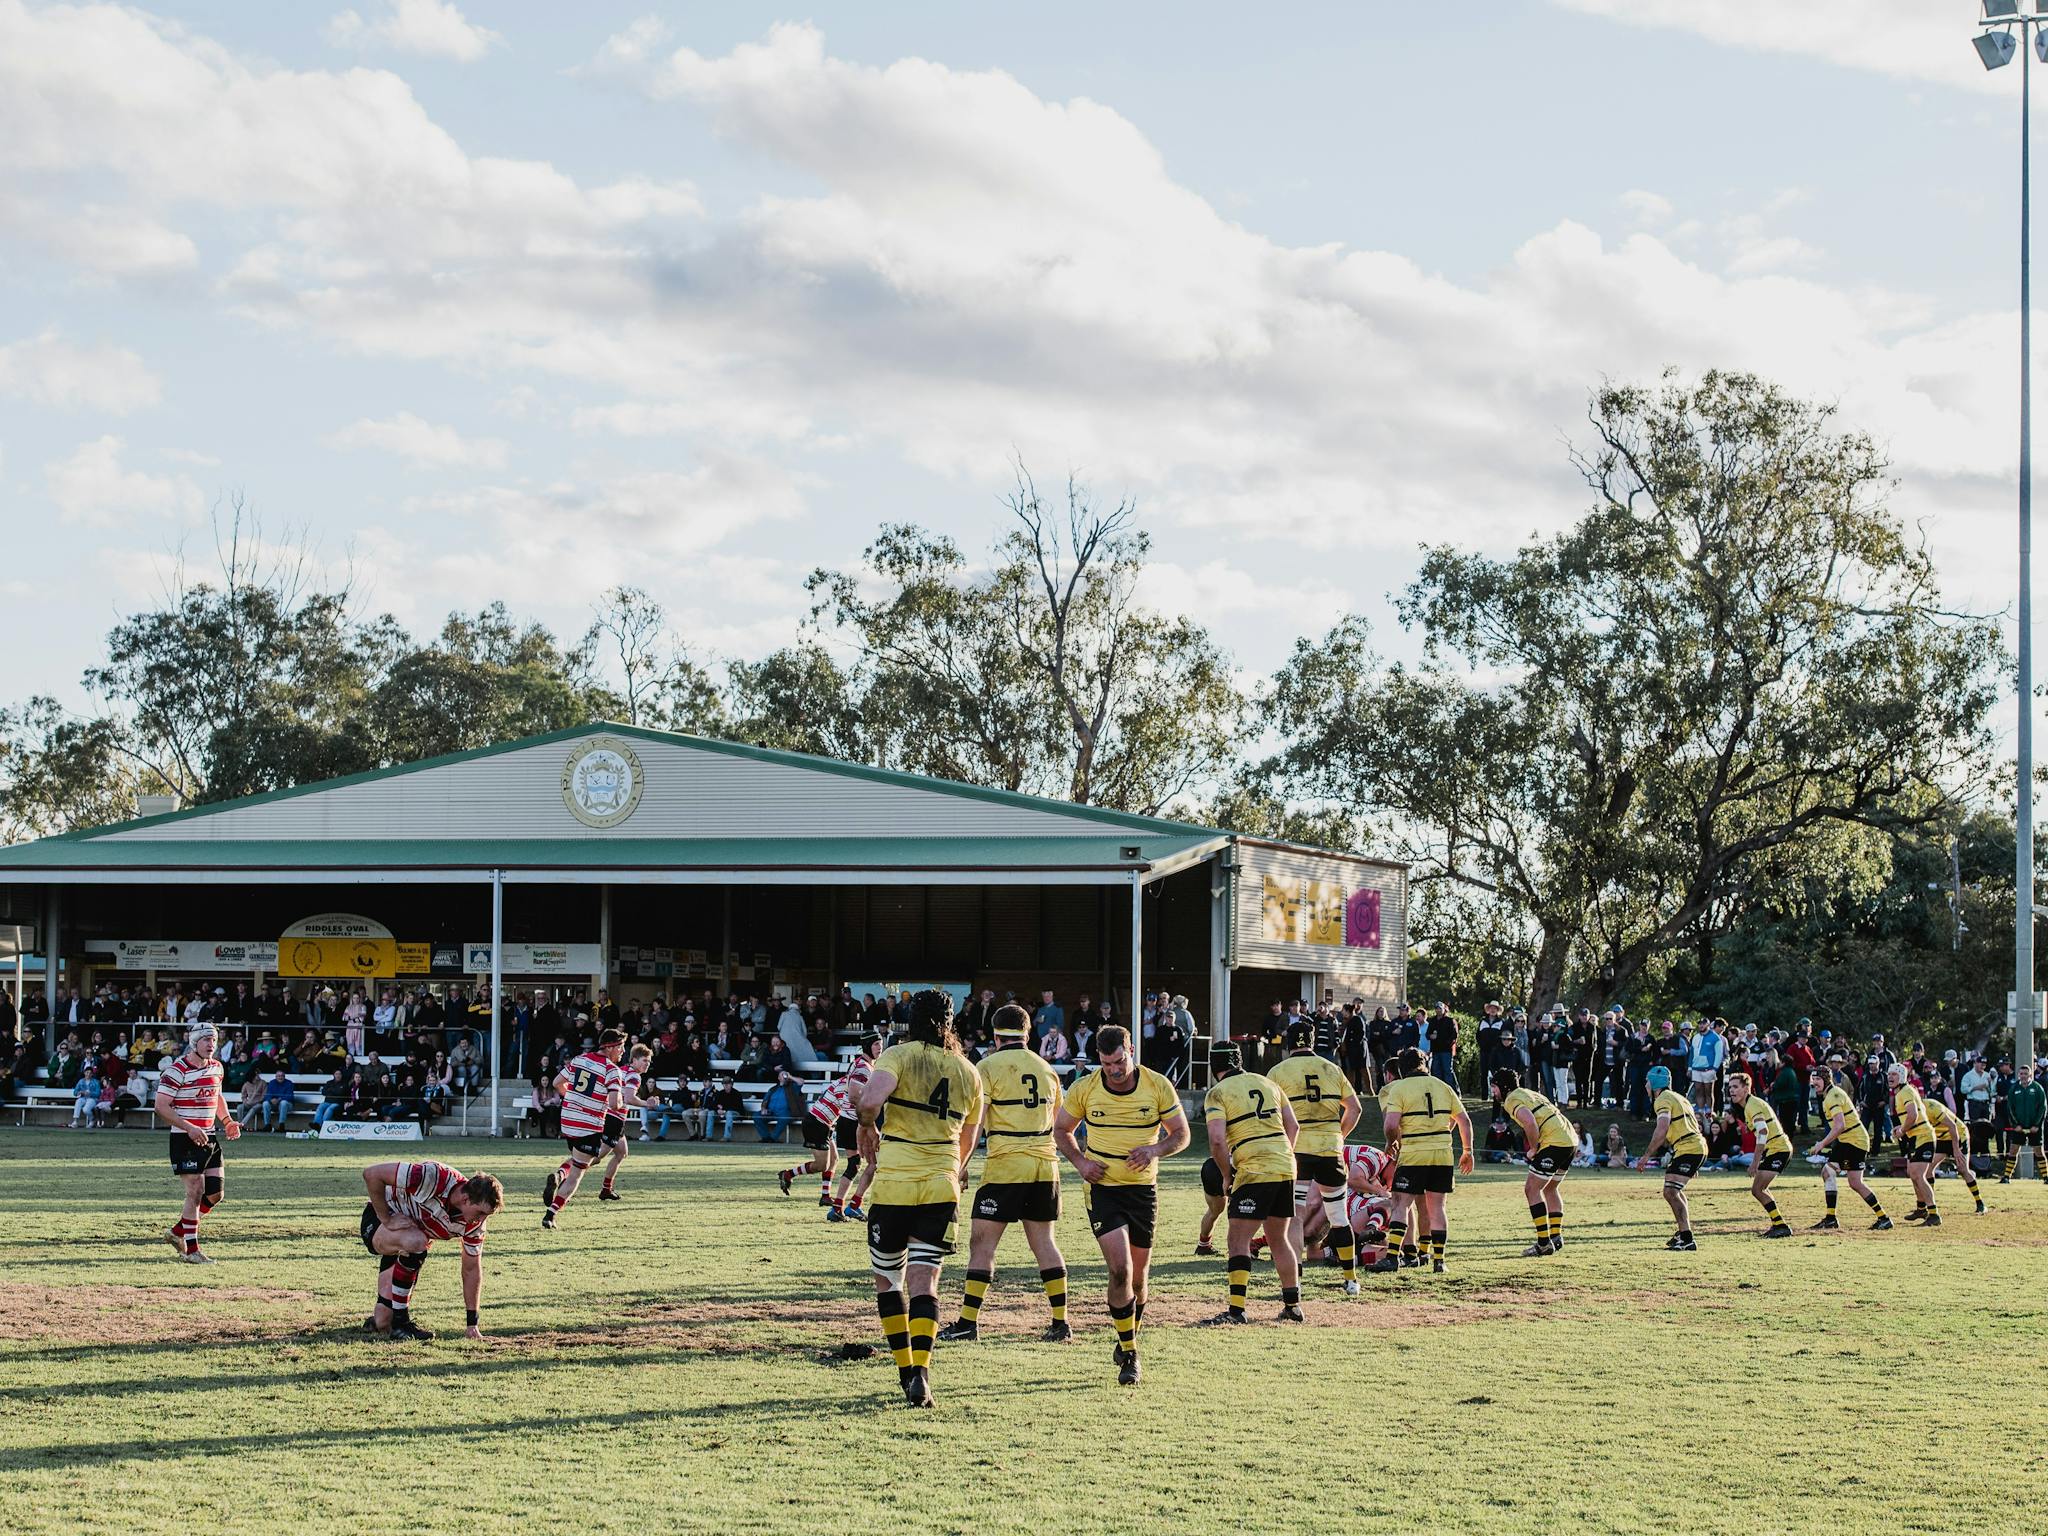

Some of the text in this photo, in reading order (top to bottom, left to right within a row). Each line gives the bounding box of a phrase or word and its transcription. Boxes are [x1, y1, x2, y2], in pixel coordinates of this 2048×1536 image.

[127, 948, 146, 956] Laser
[574, 1071, 591, 1092] 5
[1021, 1073, 1039, 1109] 3
[1304, 1074, 1321, 1102] 5
[929, 1077, 950, 1120] 4
[1248, 1089, 1272, 1119] 2
[1424, 1092, 1434, 1118] 1
